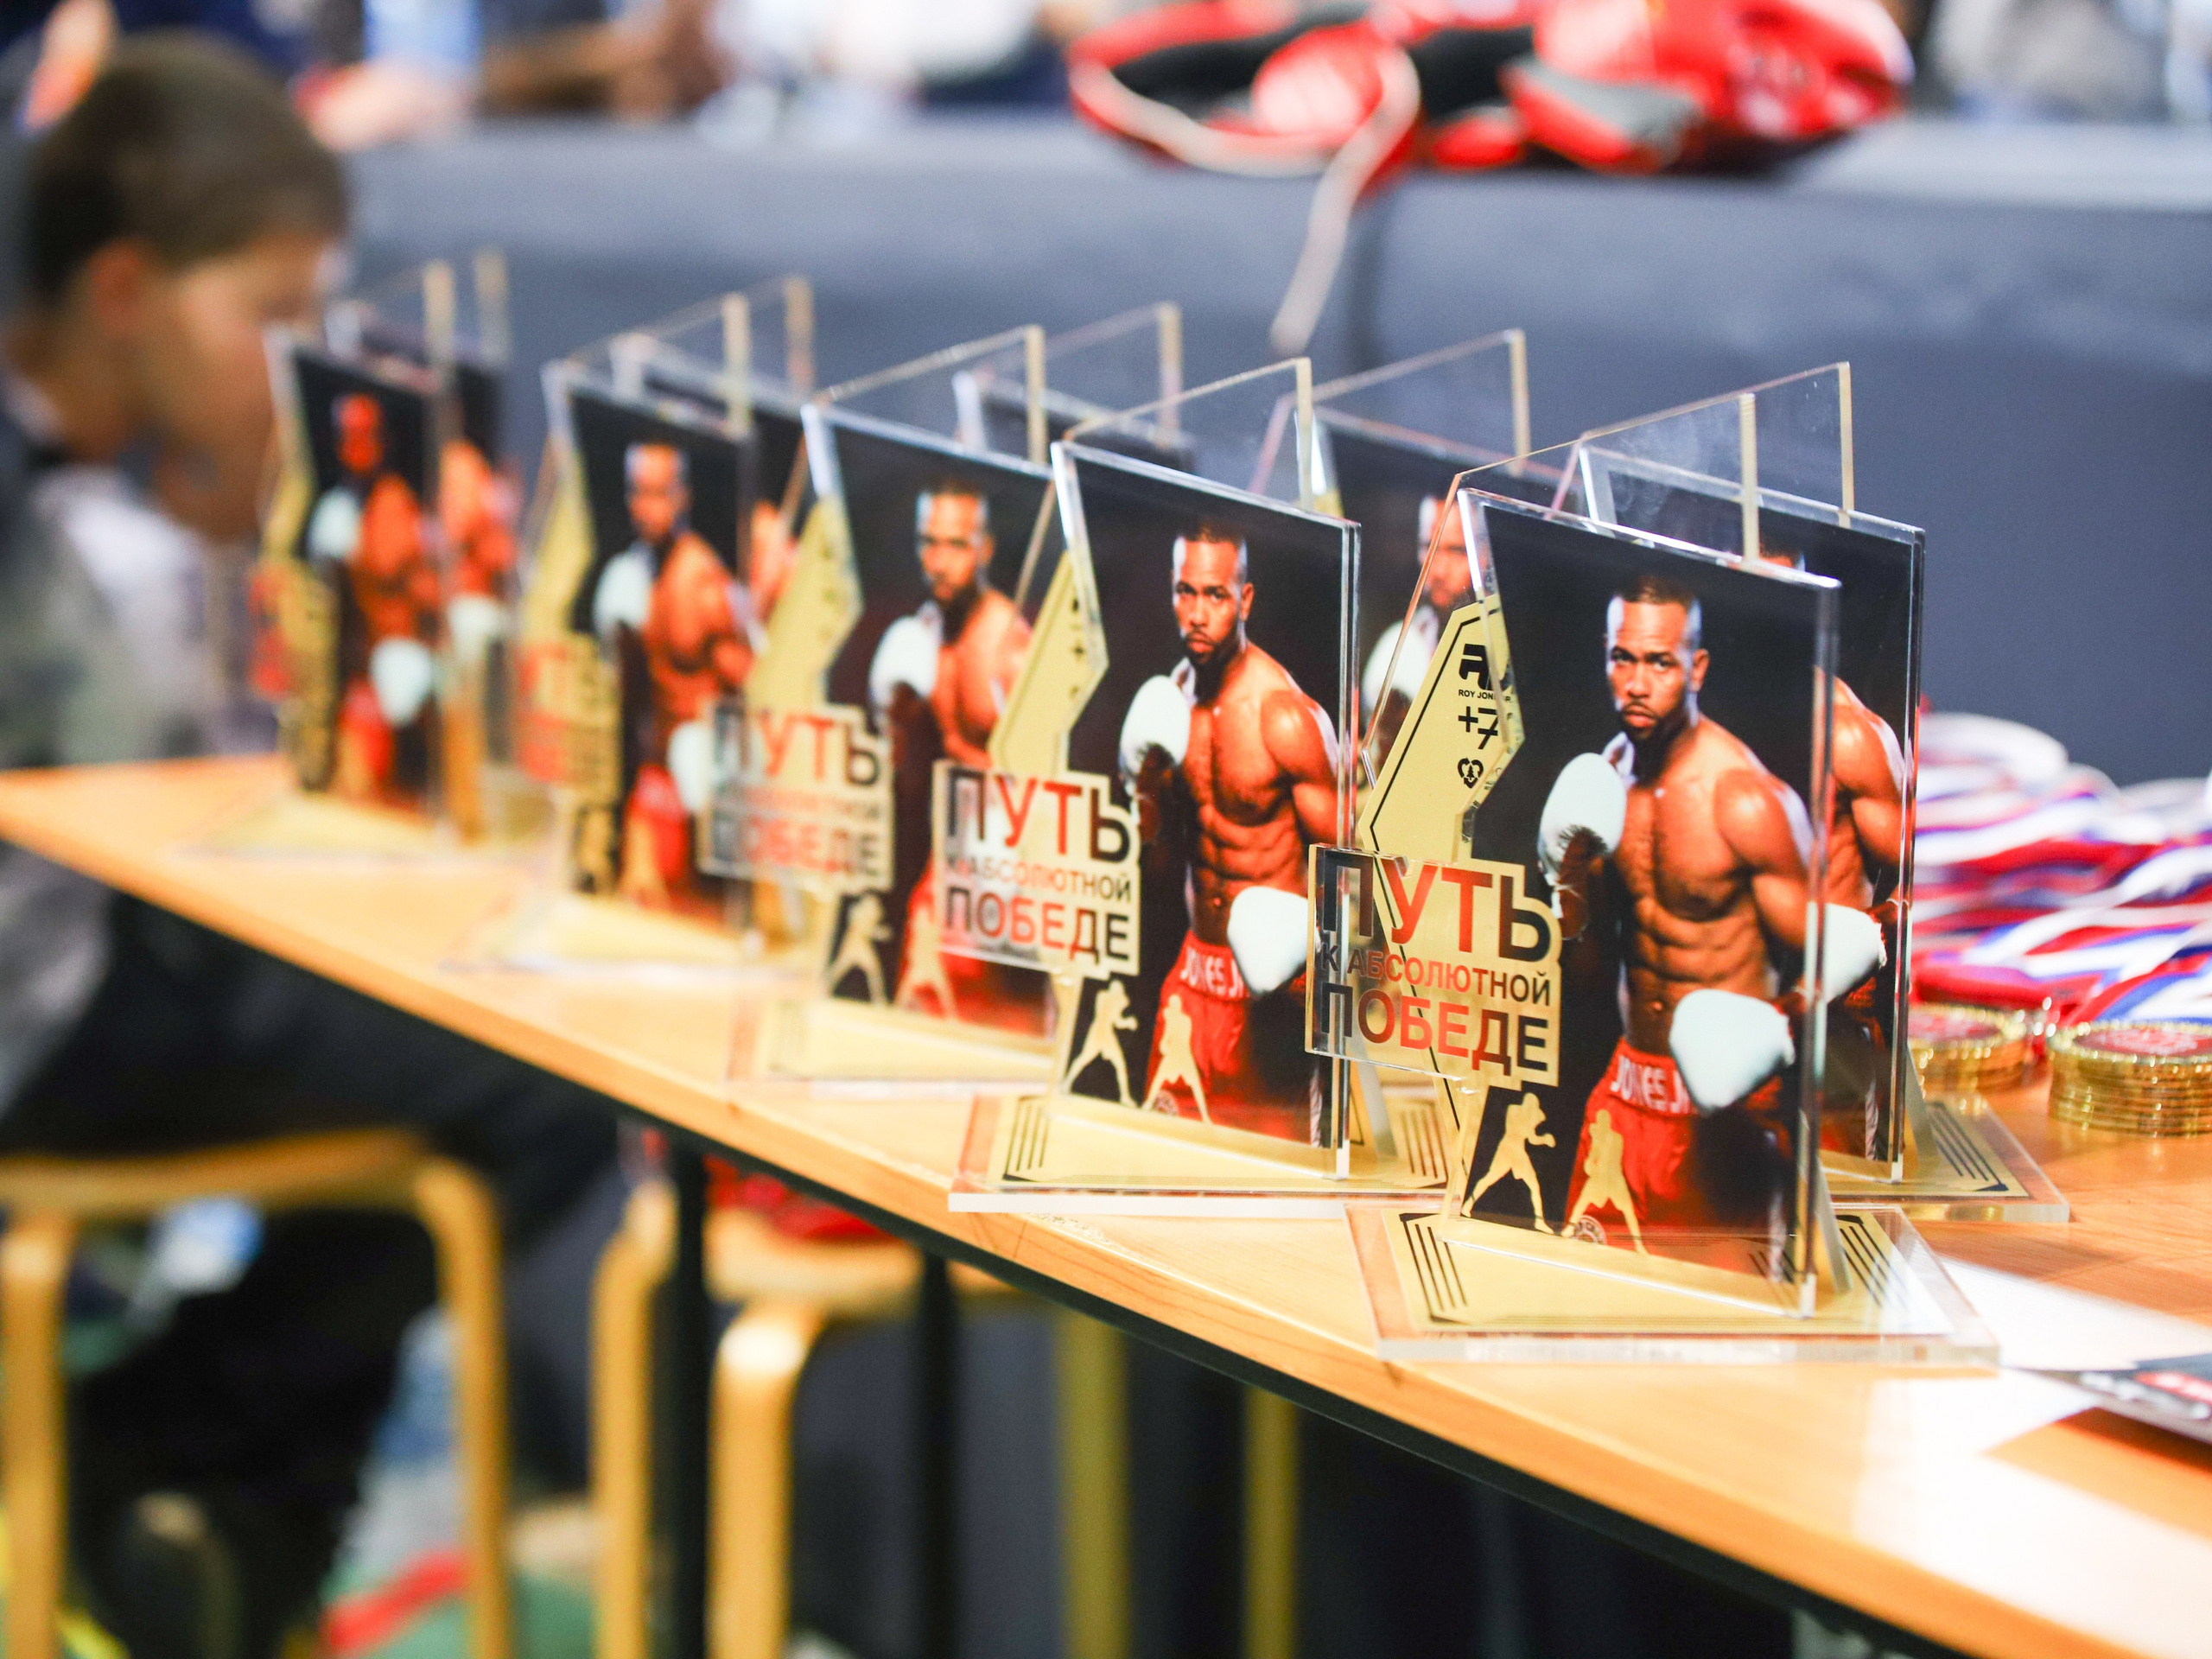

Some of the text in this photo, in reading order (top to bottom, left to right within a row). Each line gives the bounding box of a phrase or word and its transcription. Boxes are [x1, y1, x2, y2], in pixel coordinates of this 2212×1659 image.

[1458, 689, 1475, 698] ROY
[947, 766, 1131, 864] ПУТЬ
[946, 885, 1129, 965] ПОБЕДЕ
[1322, 849, 1552, 963] ПУТЬ
[1322, 942, 1551, 1007] К АБСОЛЮТНОЙ
[1320, 981, 1549, 1077] ПОБЕДЕ
